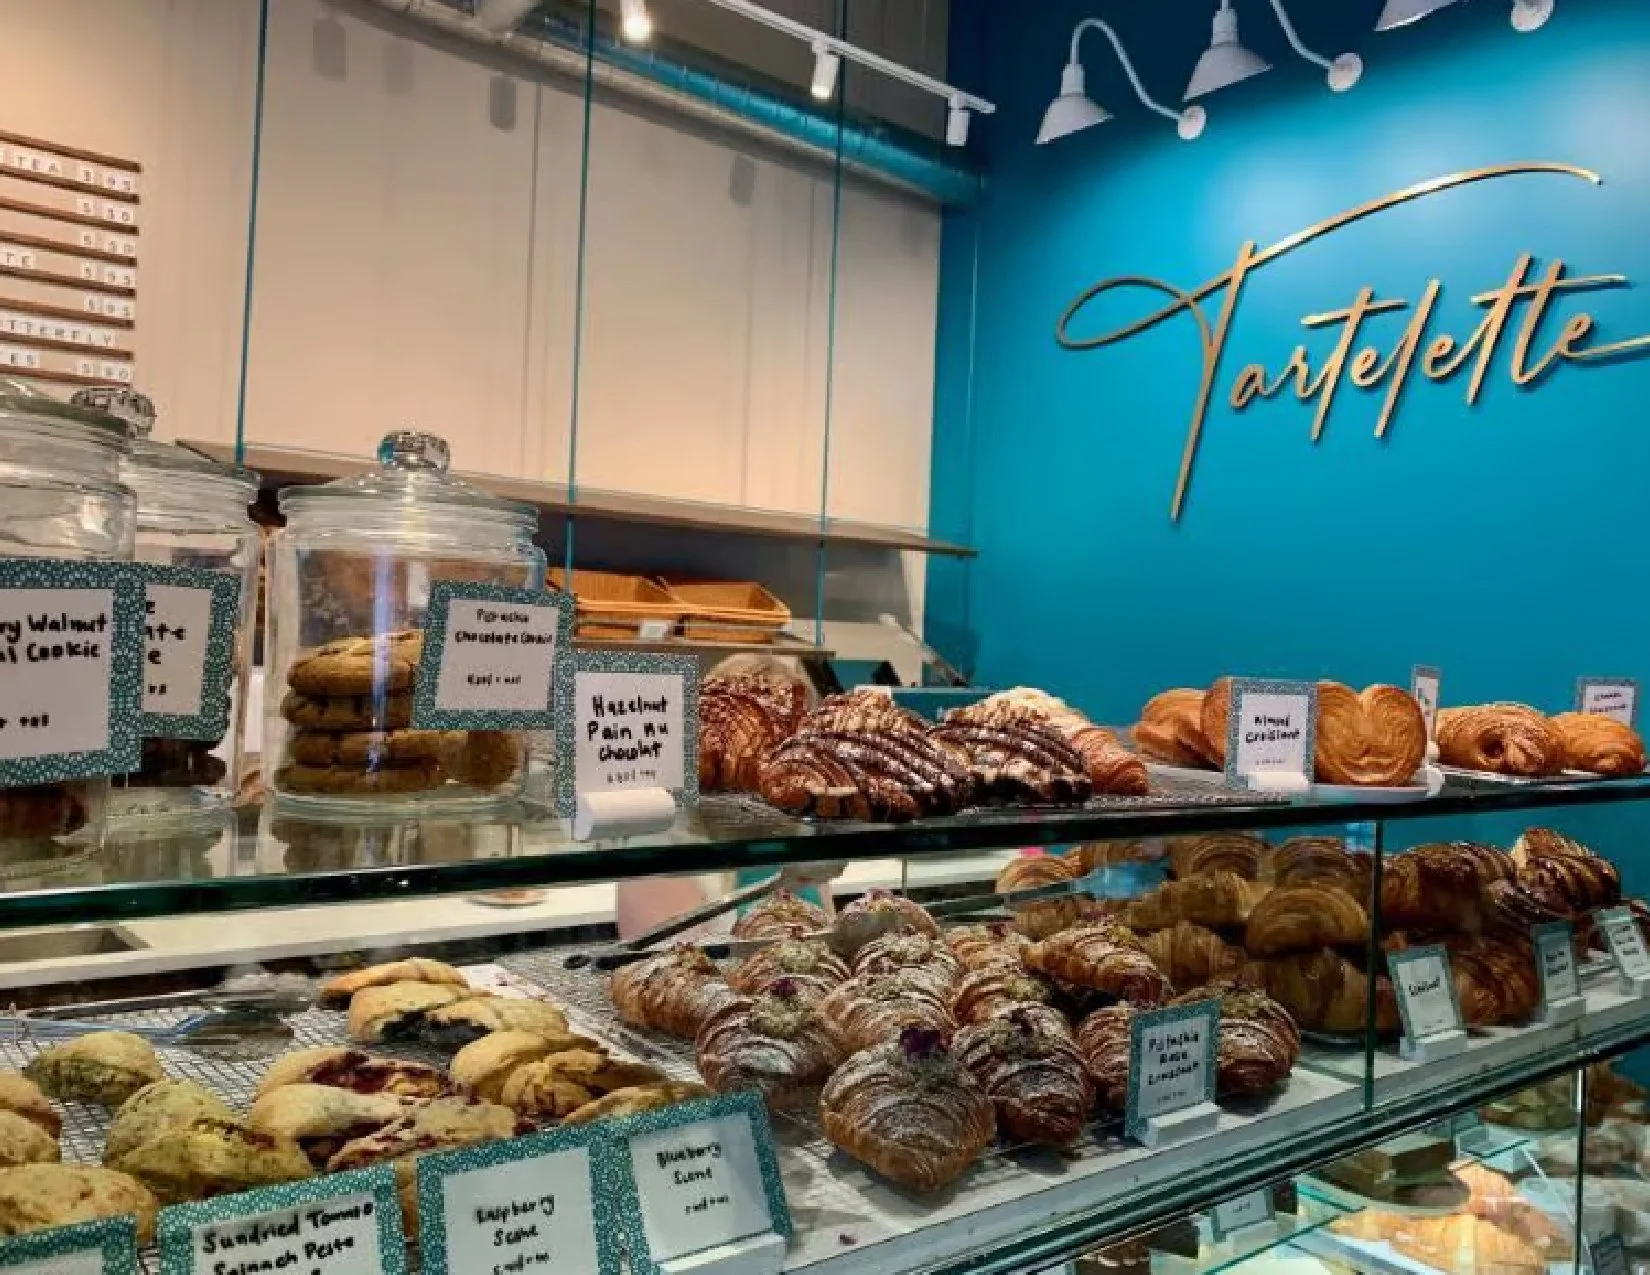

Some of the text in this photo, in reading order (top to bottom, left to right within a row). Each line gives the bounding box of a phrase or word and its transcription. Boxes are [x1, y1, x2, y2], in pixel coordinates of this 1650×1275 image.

[1055, 161, 1650, 522] Tartelette
[26, 612, 108, 633] Walnut
[26, 640, 101, 663] Cookie
[592, 695, 669, 718] Hazelnut
[586, 720, 632, 741] Pain
[202, 1212, 300, 1254] Sundried
[493, 1224, 539, 1247] Scone
